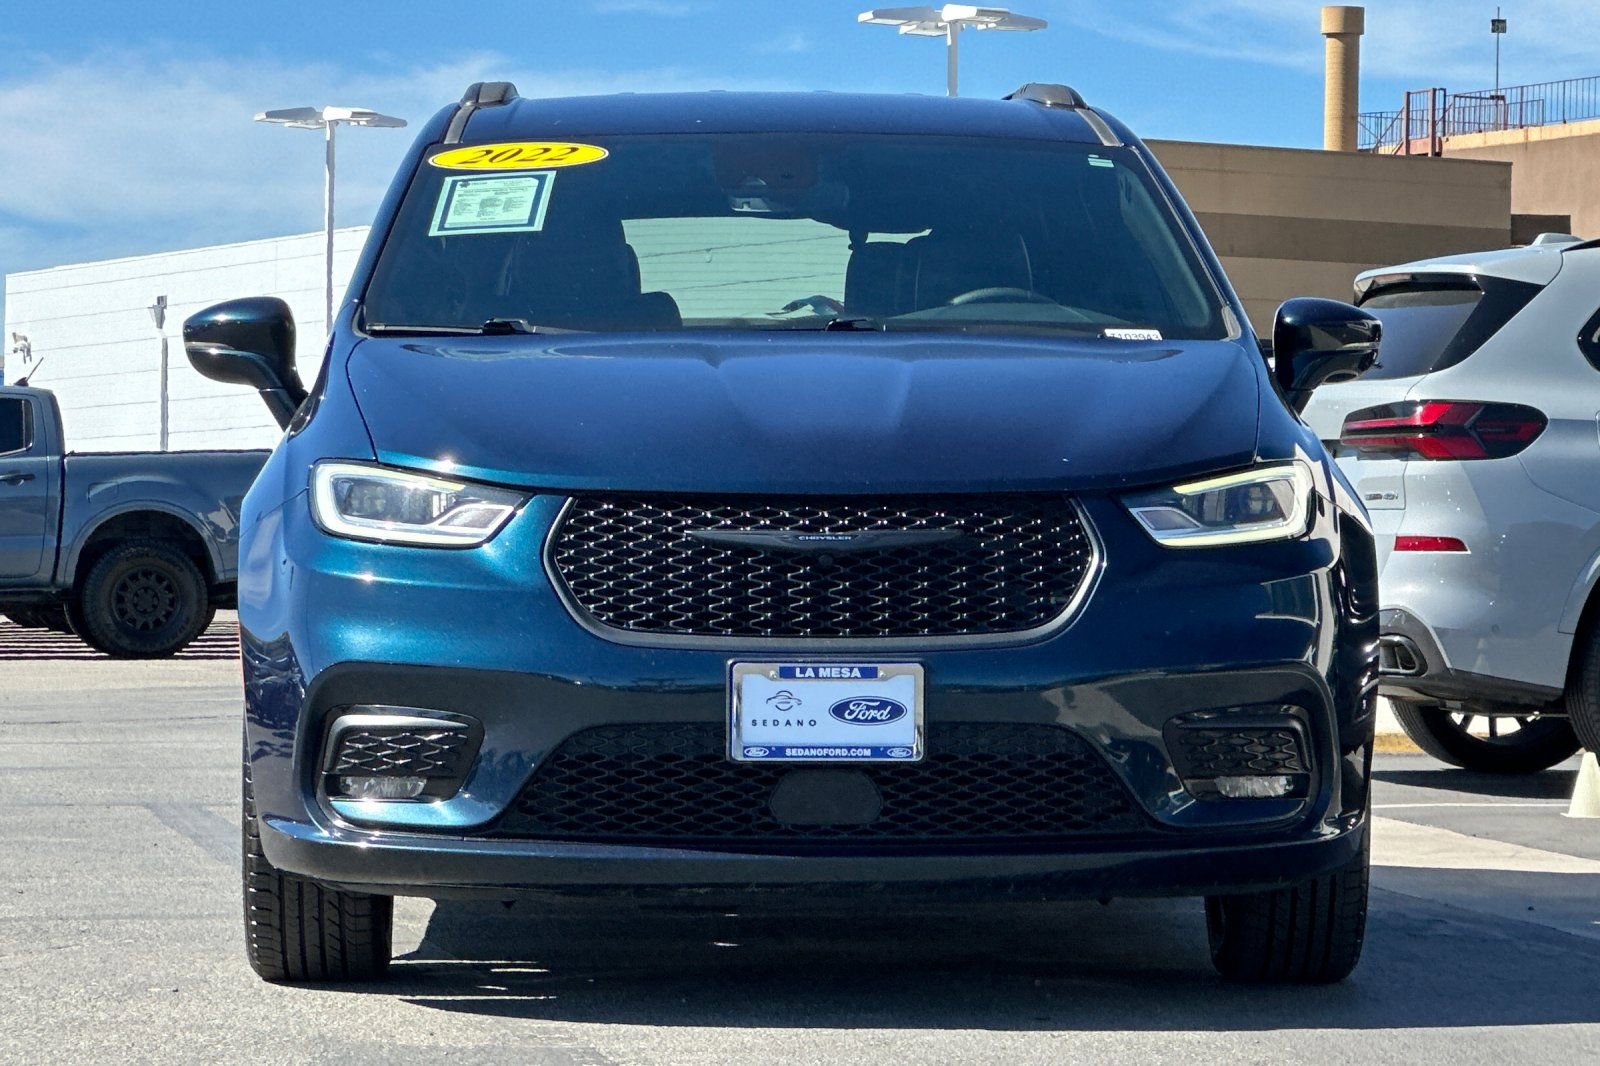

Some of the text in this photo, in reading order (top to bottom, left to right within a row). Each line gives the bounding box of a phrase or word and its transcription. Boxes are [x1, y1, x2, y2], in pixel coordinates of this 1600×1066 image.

[456, 146, 580, 165] 2022
[795, 667, 862, 678] LA MESA
[844, 700, 891, 721] Ford
[751, 719, 817, 727] SEDANO
[785, 748, 871, 757] SEDANOFORD.COM
